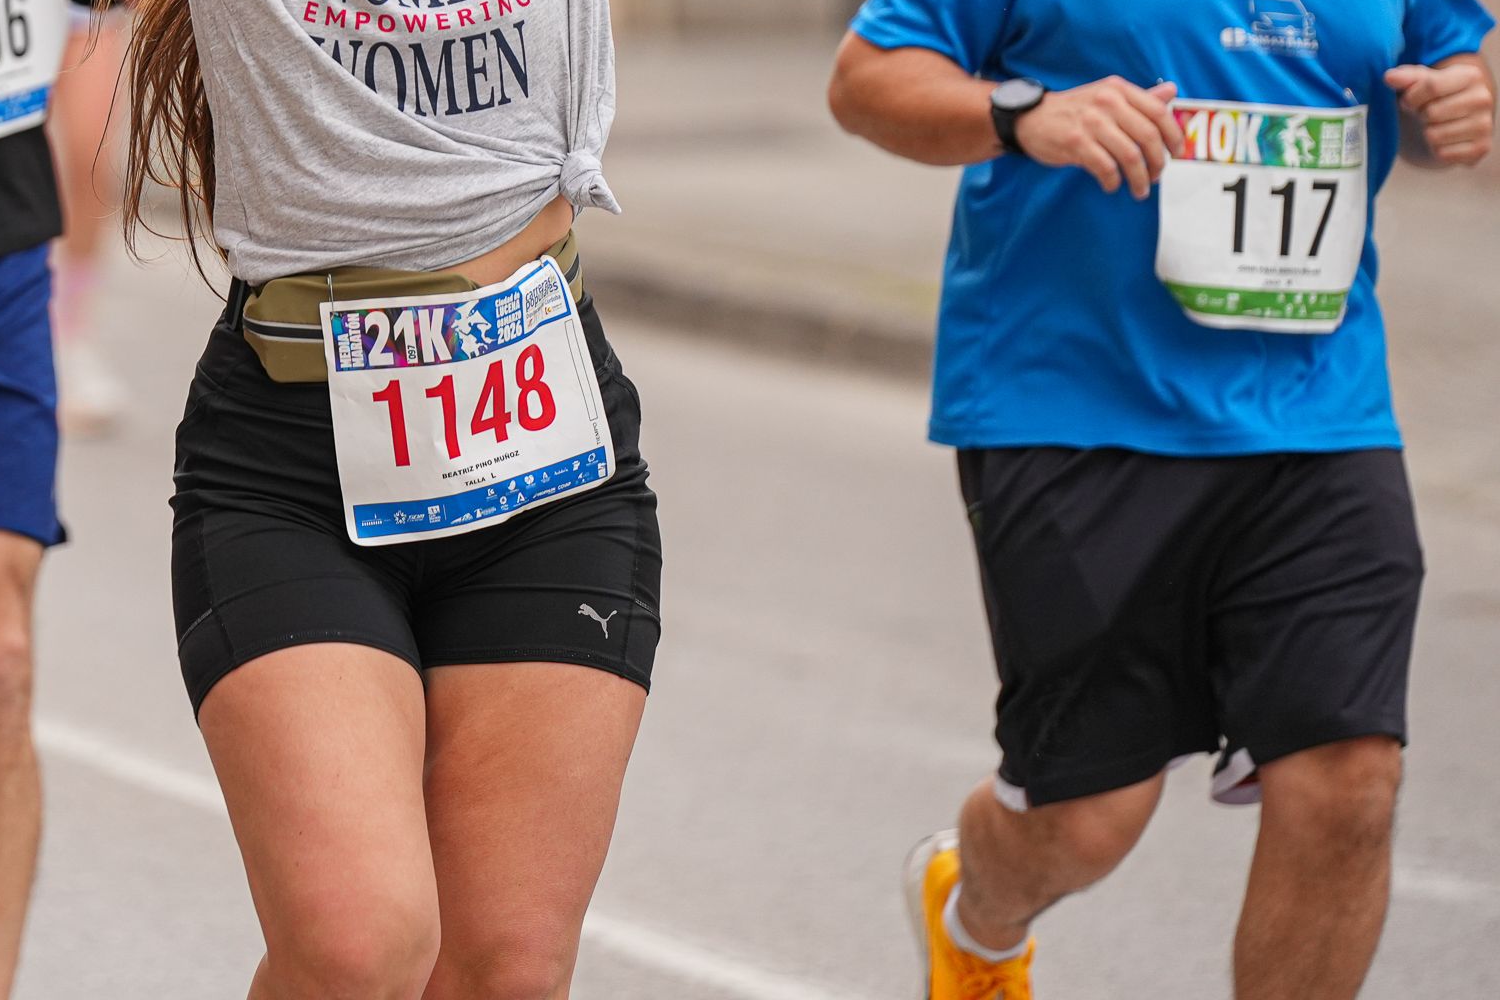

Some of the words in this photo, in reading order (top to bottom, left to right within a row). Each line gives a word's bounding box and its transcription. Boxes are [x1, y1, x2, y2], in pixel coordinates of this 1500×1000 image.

[1187, 111, 1264, 165] 10K
[1223, 175, 1339, 258] 117
[345, 313, 365, 368] MARATÓN
[364, 307, 453, 367] 21K
[498, 320, 523, 345] 2026
[372, 343, 557, 467] 1148
[442, 465, 475, 480] BEATRIZ
[475, 459, 493, 470] PINO
[493, 450, 520, 464] MUÑOZ
[465, 477, 486, 487] TALLA
